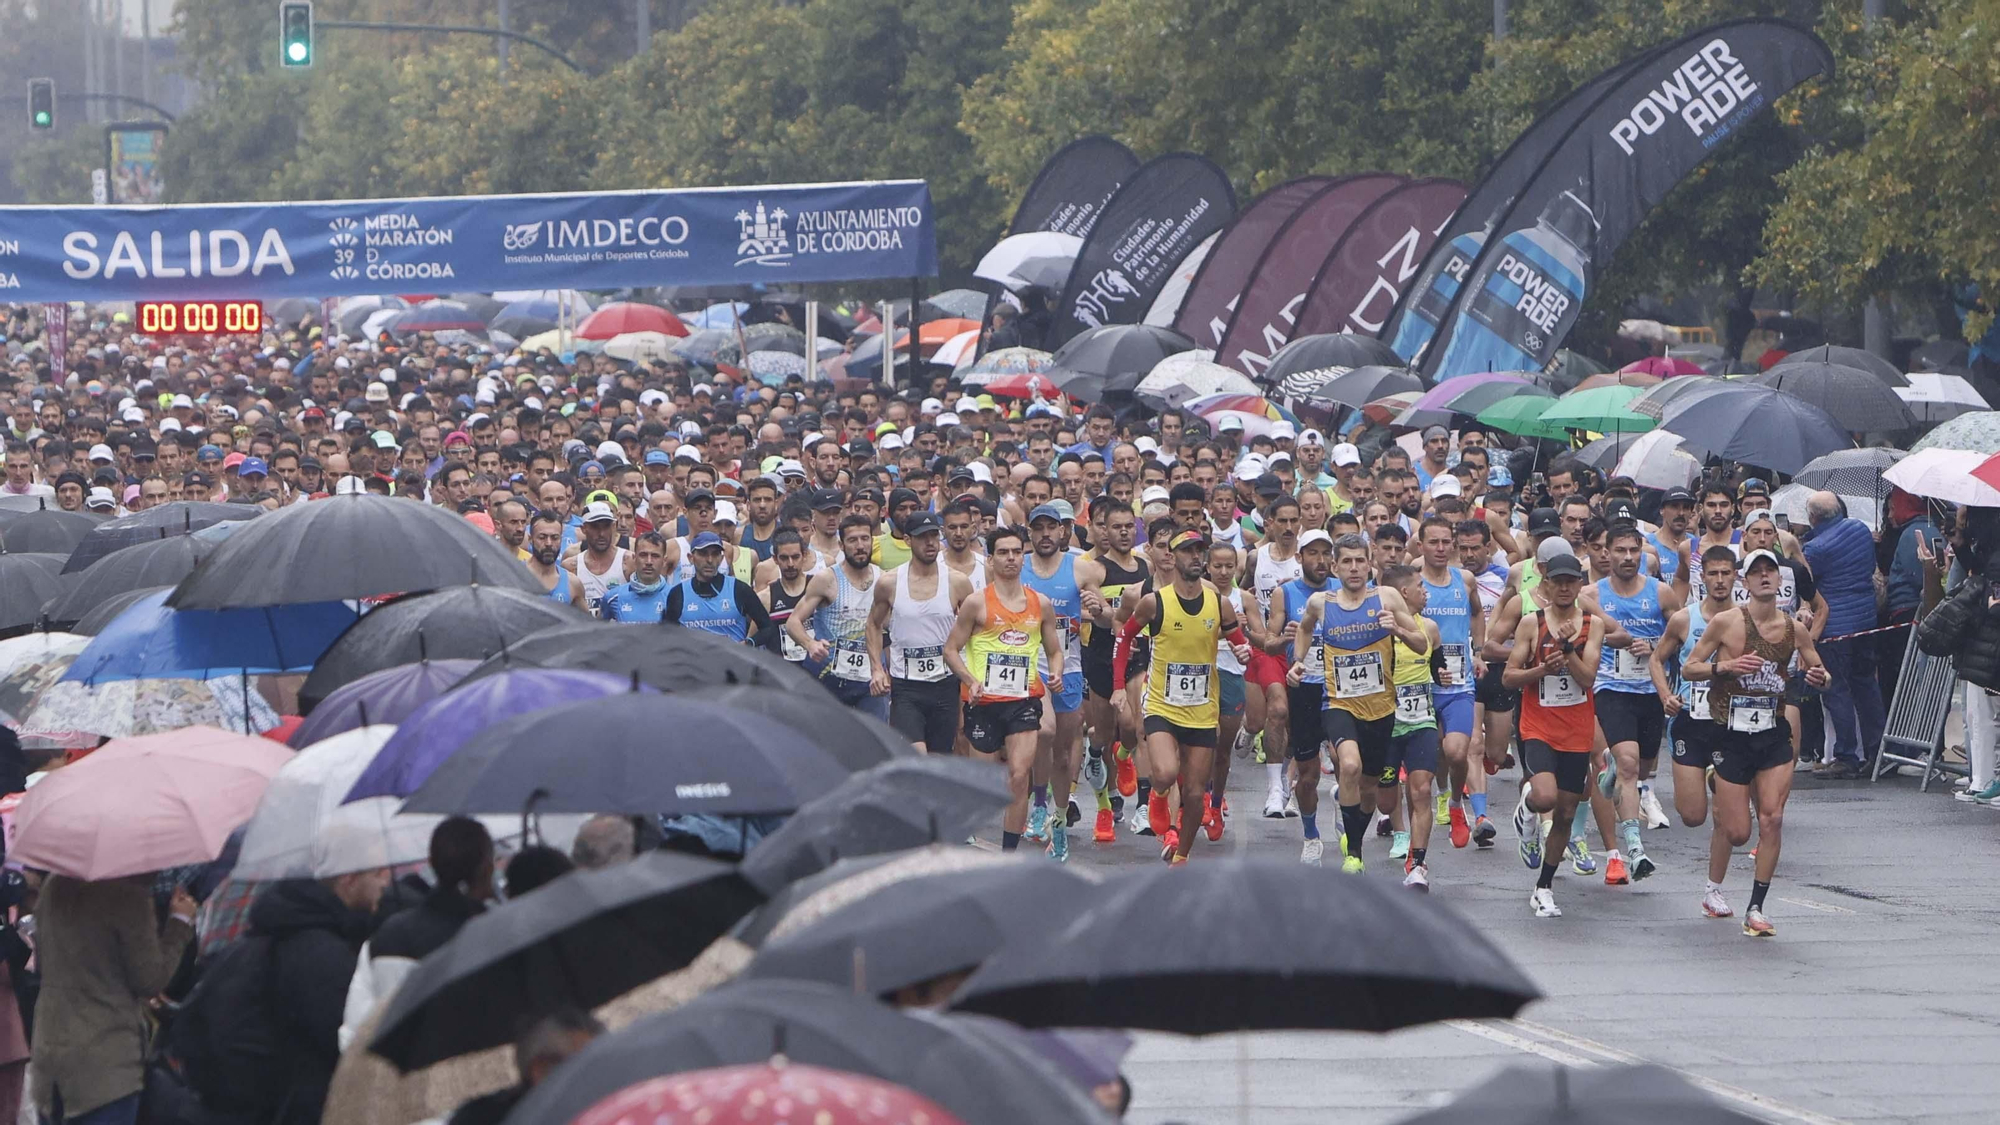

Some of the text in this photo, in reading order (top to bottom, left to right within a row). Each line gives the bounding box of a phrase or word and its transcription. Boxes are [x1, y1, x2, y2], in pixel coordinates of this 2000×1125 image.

[1609, 38, 1739, 156] POWER
[1682, 62, 1758, 136] ADE
[364, 214, 420, 230] MEDIA
[796, 206, 922, 232] AYUNTAMIENTO
[365, 226, 452, 246] MARATÓN
[547, 216, 689, 248] IMDECO
[797, 229, 903, 254] DE CÓRDOBA
[1112, 218, 1156, 263] Ciudades
[1135, 198, 1210, 281] de la Humanidad
[62, 228, 294, 279] SALIDA
[1123, 218, 1174, 272] Patrimonio
[334, 248, 354, 264] 39
[504, 254, 543, 264] Instituto
[544, 252, 590, 263] Municipal
[591, 252, 604, 261] de
[606, 250, 648, 261] Deportes
[366, 260, 454, 280] CÓRDOBA
[1496, 254, 1570, 318] POWER
[143, 303, 259, 332] 00 00 00
[1516, 293, 1558, 335] ADE
[686, 618, 737, 628] TROTASIERRA
[1328, 622, 1380, 638] agustinos
[848, 654, 864, 667] 48
[918, 660, 934, 672] 36
[999, 668, 1016, 682] 41
[1180, 678, 1196, 690] 61
[1350, 667, 1368, 681] 44
[1560, 678, 1568, 690] 3
[1404, 698, 1420, 712] 37
[1750, 712, 1760, 724] 4
